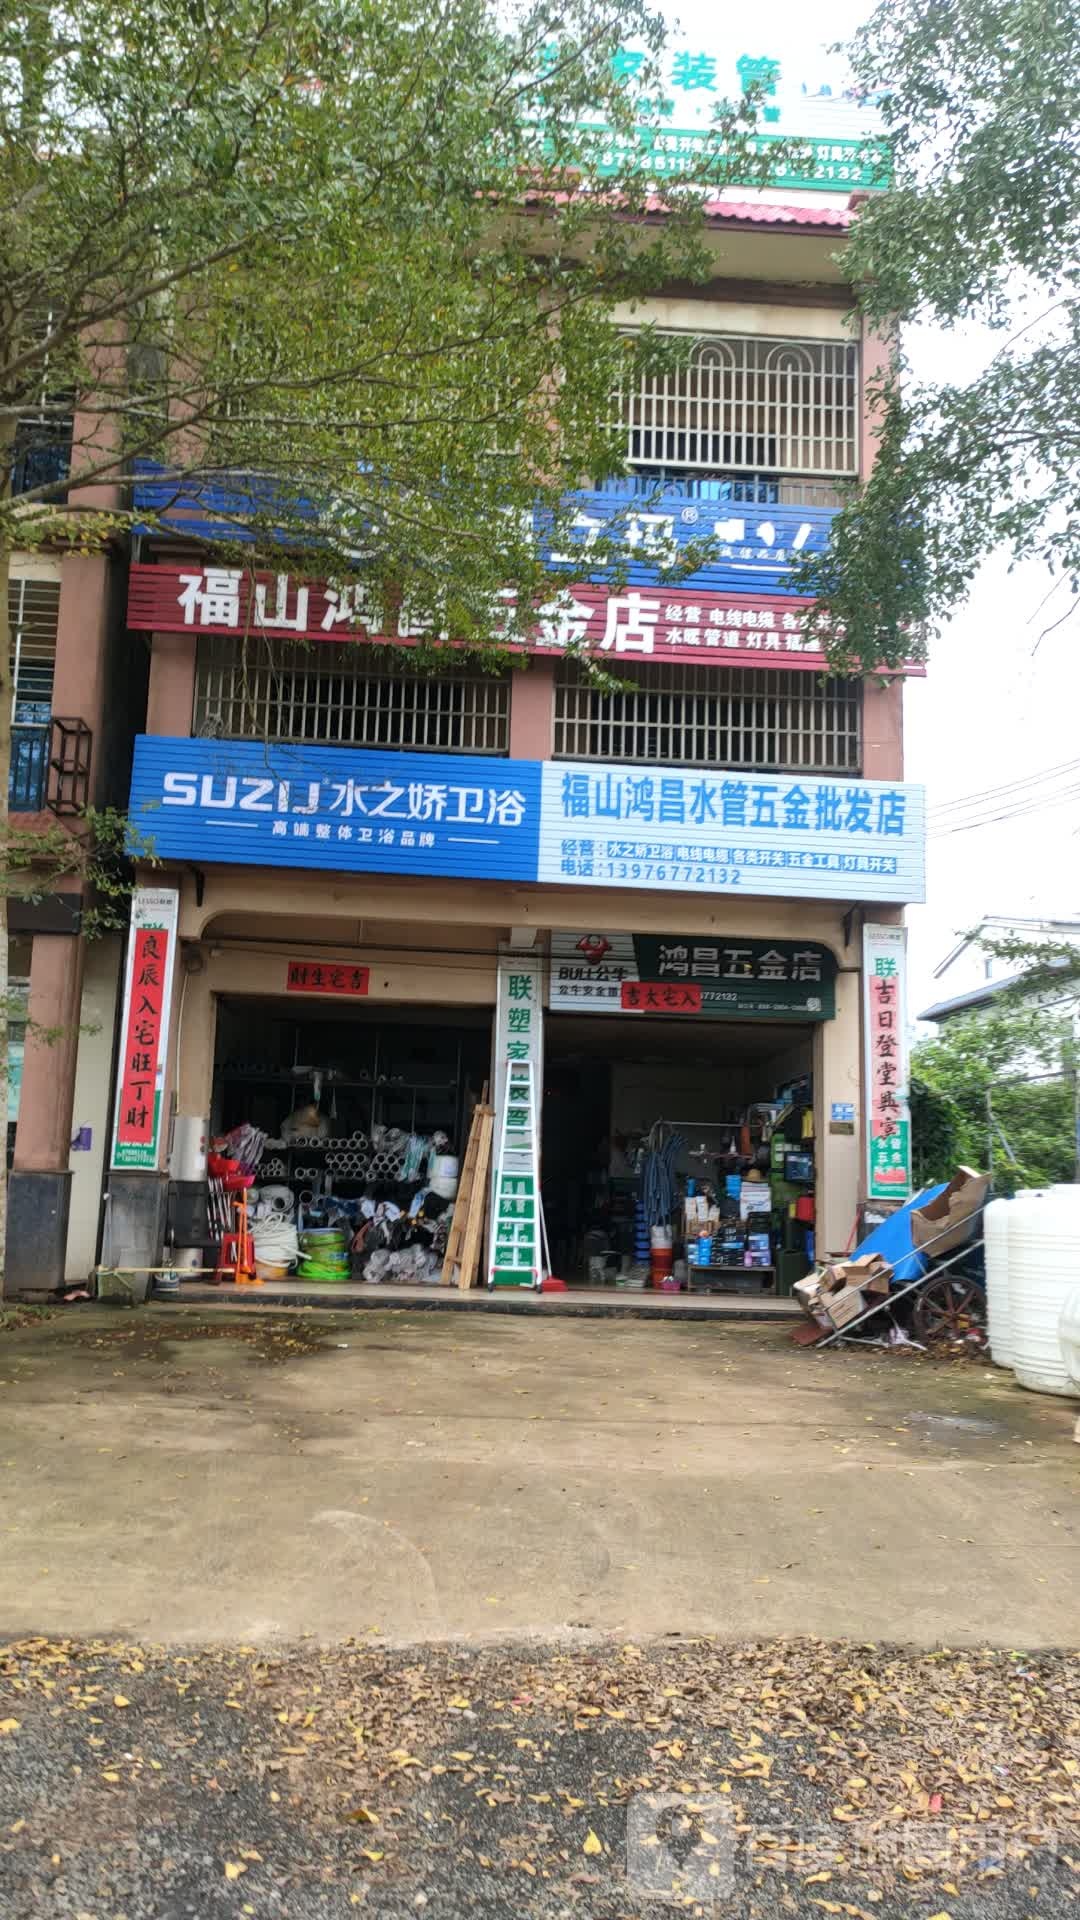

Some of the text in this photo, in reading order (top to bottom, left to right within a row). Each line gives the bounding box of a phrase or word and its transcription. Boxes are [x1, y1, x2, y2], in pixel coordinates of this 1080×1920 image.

[666, 605, 702, 625] 经营
[710, 607, 776, 629] 电线电缆
[665, 627, 701, 647] 水暖
[705, 629, 740, 648] 管道
[747, 631, 781, 650] 灯具
[330, 777, 527, 826] 水之娇卫浴
[561, 771, 906, 838] 福山鸿昌水管五金批发店
[272, 819, 436, 849] 高端整体卫浴品牌
[608, 842, 674, 861] 水之娇卫浴
[677, 845, 729, 864] 电线电缆
[732, 848, 785, 866] 各类开关
[788, 850, 841, 870] 五金工具
[843, 854, 897, 874] 灯具开关
[658, 944, 824, 981] 鸿昌五金店
